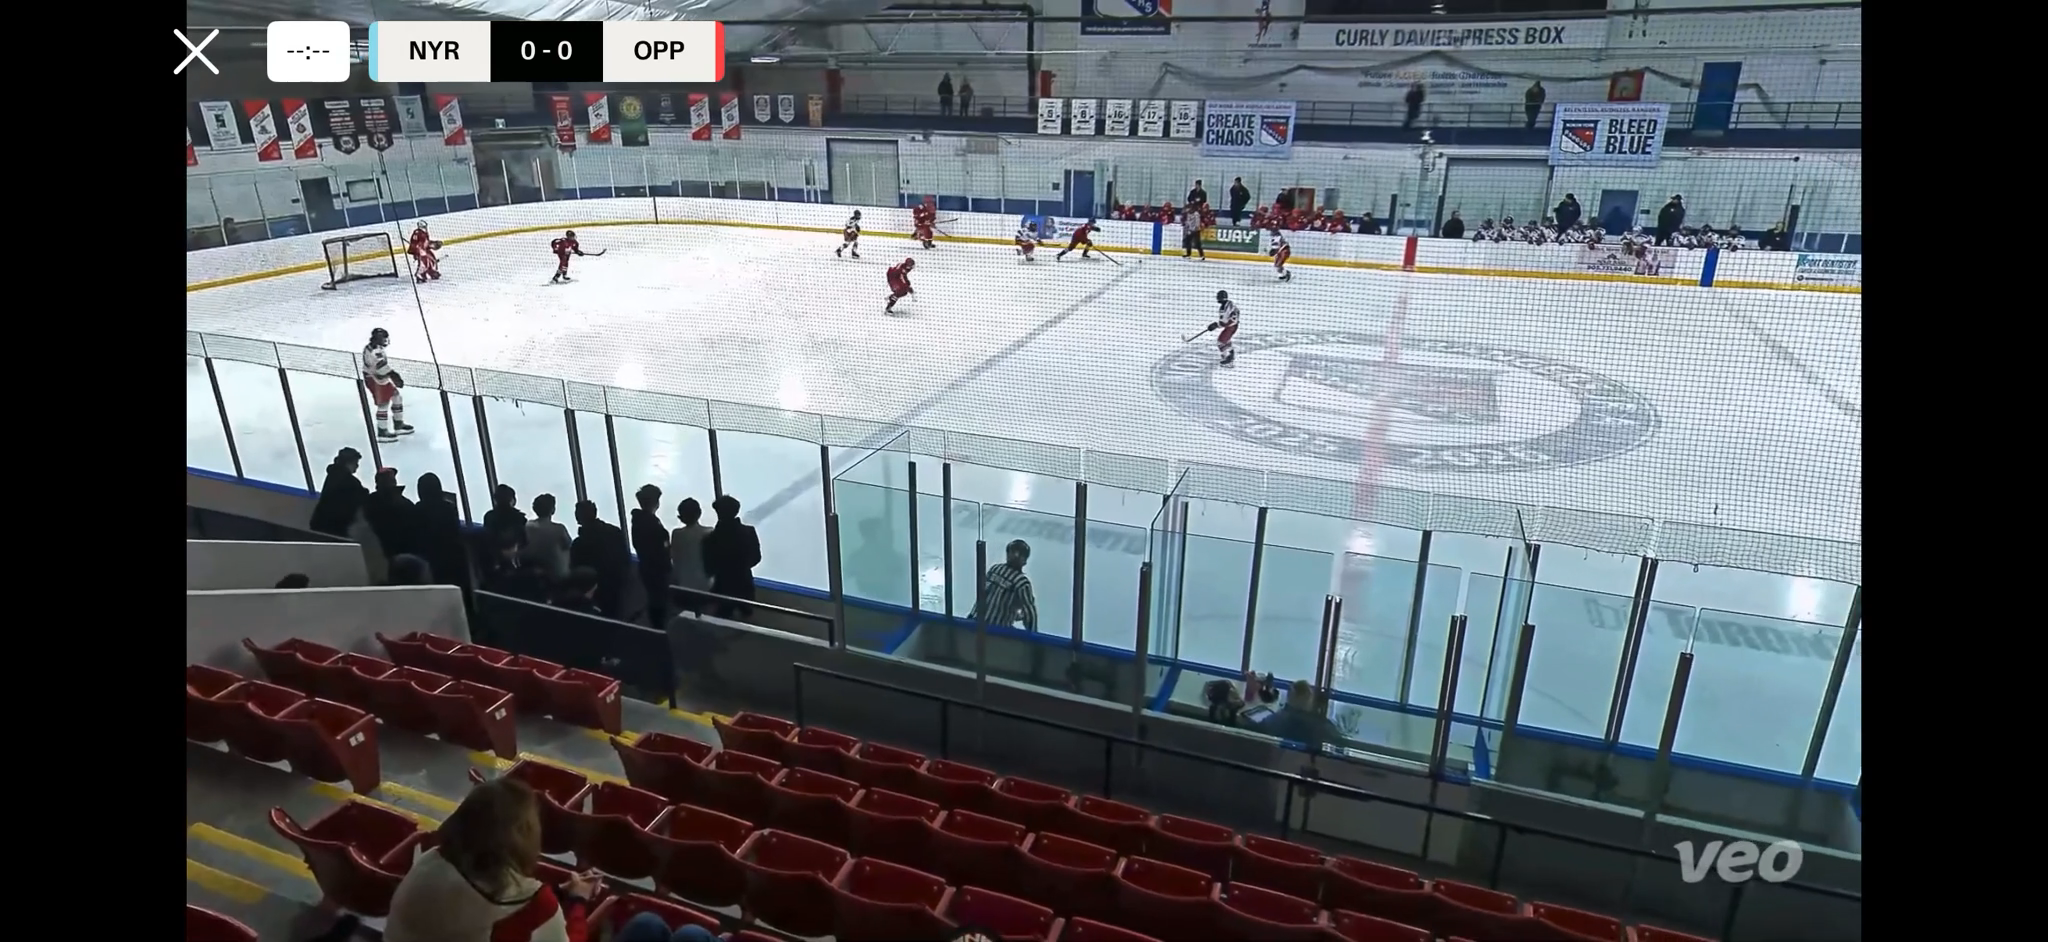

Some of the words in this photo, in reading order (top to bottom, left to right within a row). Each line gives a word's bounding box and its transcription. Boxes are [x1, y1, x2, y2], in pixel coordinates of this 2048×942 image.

[1335, 28, 1389, 47] CURLY
[1460, 27, 1522, 46] PRESS
[1524, 26, 1565, 45] BOX
[1147, 111, 1157, 120] 17
[1207, 113, 1256, 129] CREATE
[1608, 118, 1658, 135] BLEED
[1206, 129, 1255, 147] CHAOS
[1605, 135, 1655, 155] BLUE
